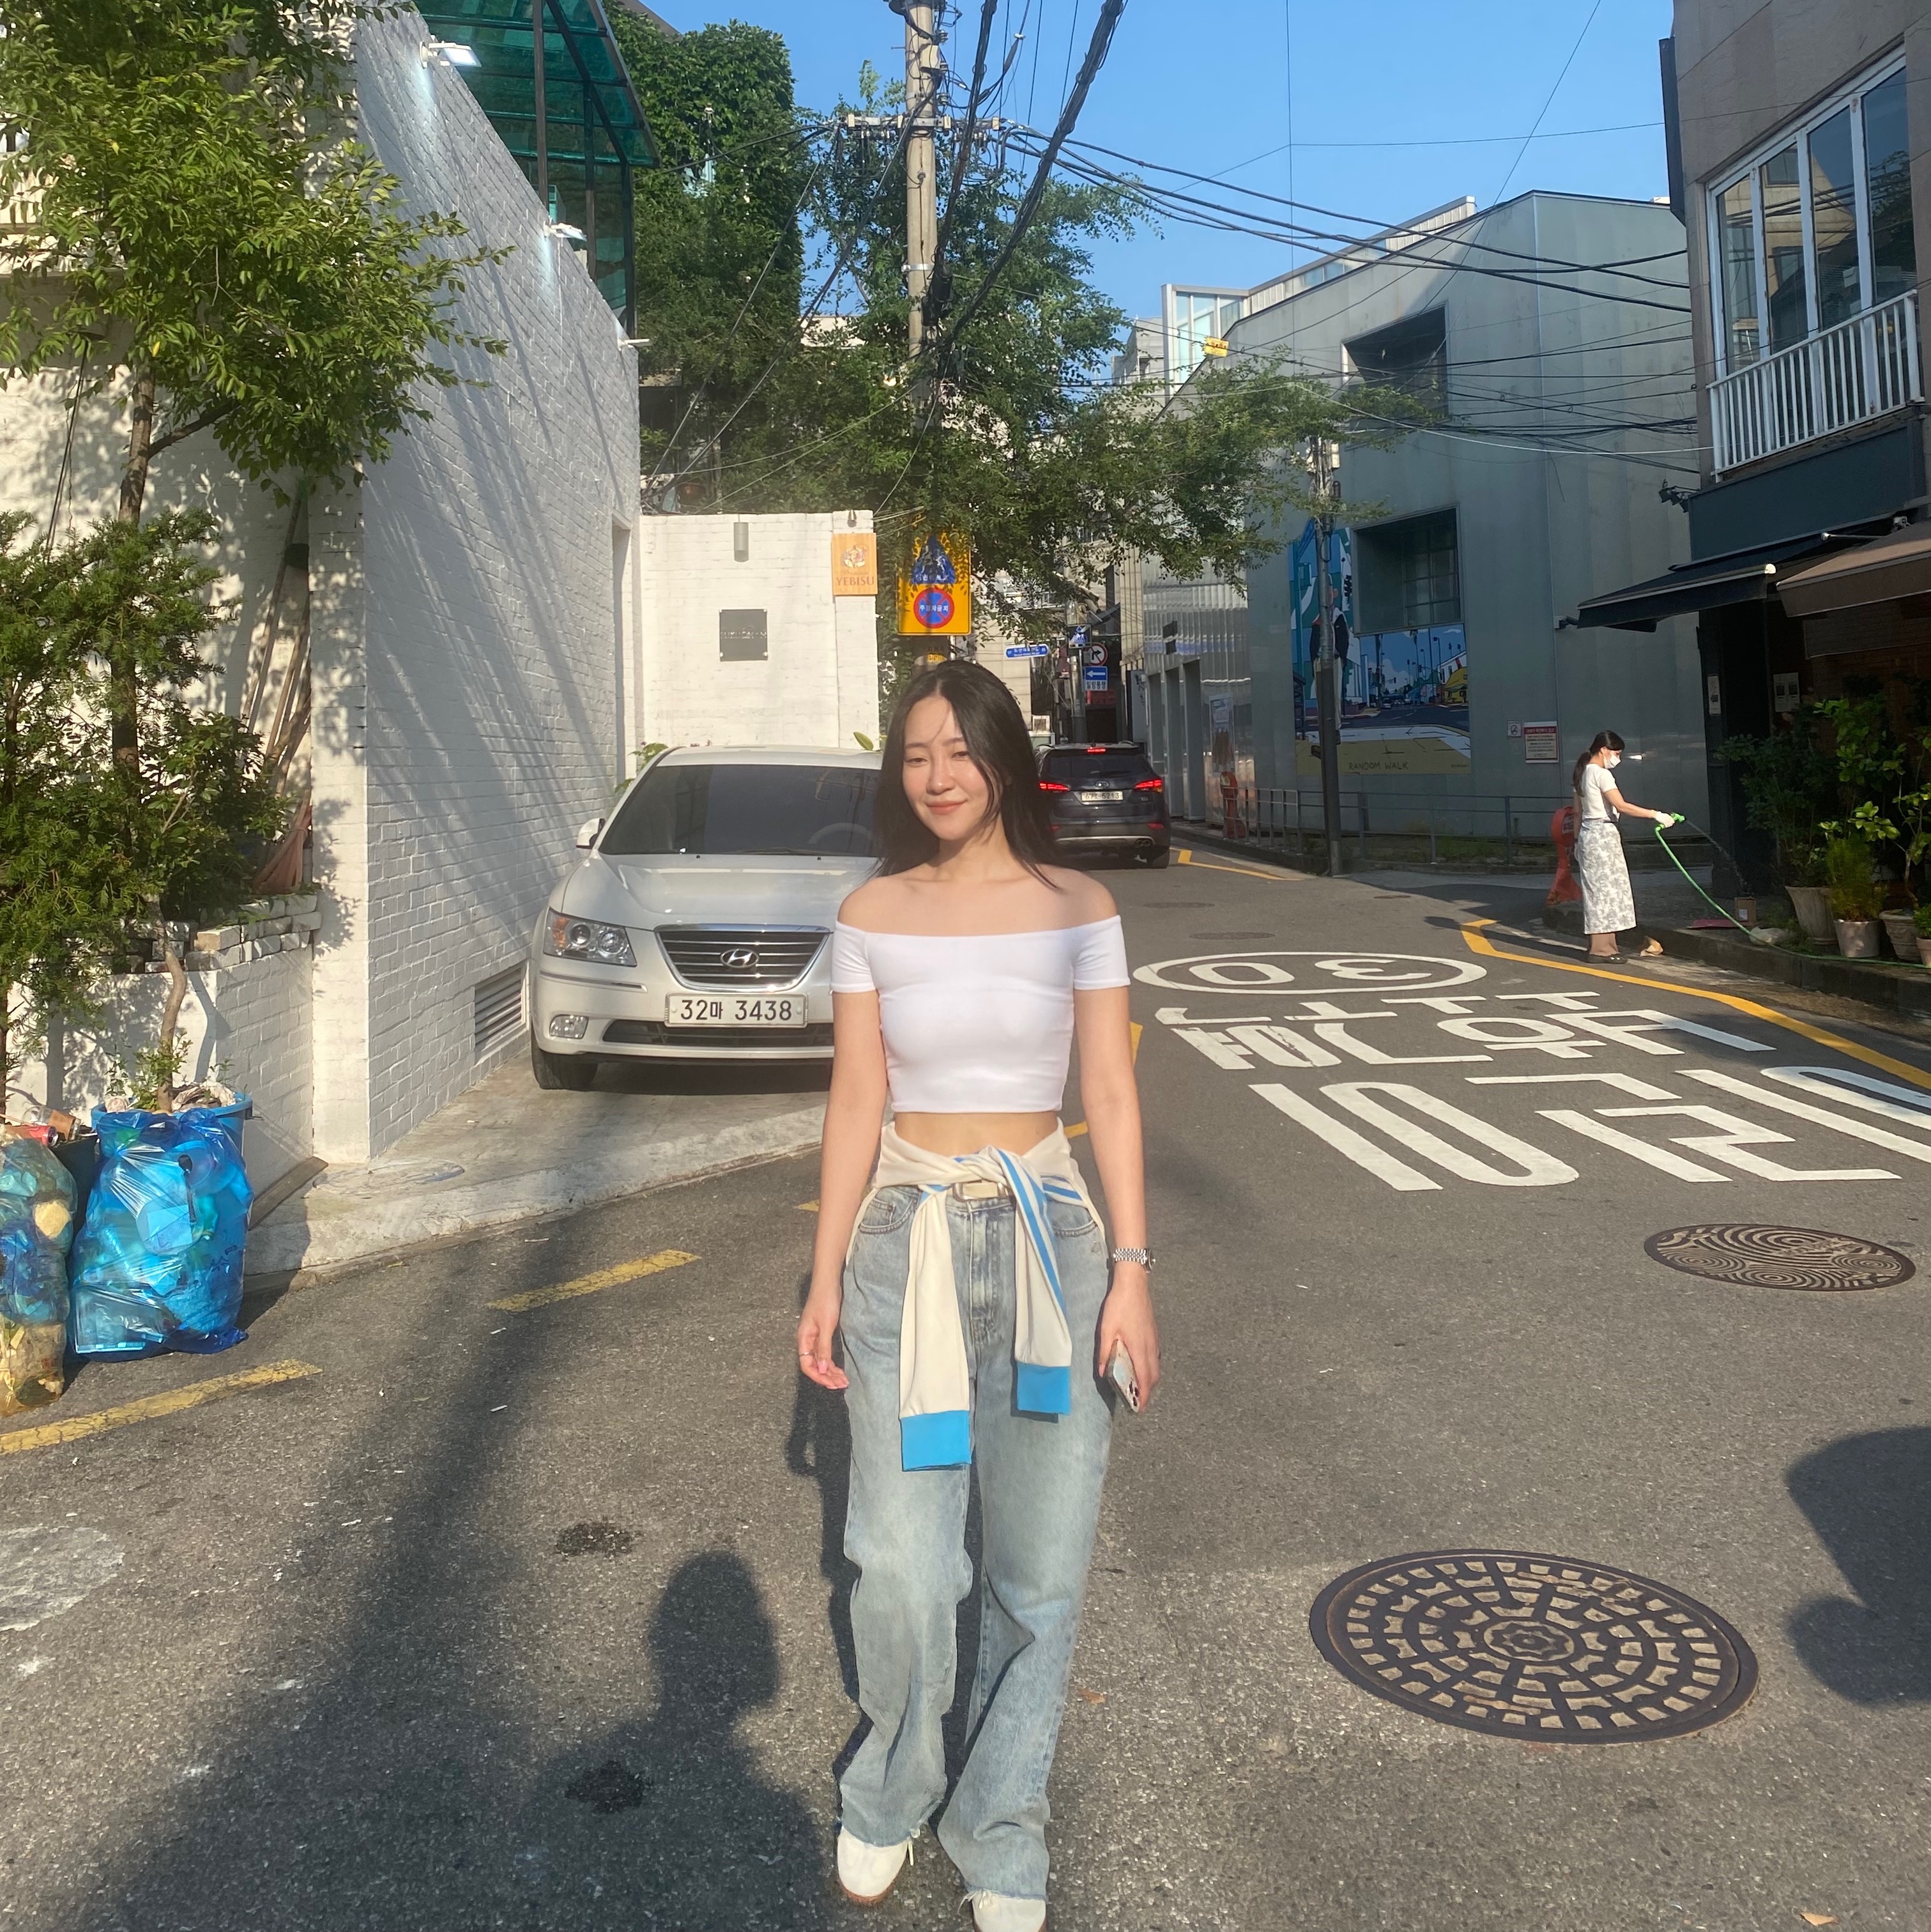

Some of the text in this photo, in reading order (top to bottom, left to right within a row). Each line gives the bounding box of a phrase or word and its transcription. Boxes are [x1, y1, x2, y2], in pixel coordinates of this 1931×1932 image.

[836, 576, 874, 586] YEBISU
[919, 604, 949, 613] 주정차금지
[1086, 681, 1106, 689] 일방통행
[1348, 761, 1408, 770] RANDOM WALK
[1188, 958, 1433, 986] 30
[680, 999, 793, 1022] 32마 3438
[1155, 991, 1777, 1070] 보호구역
